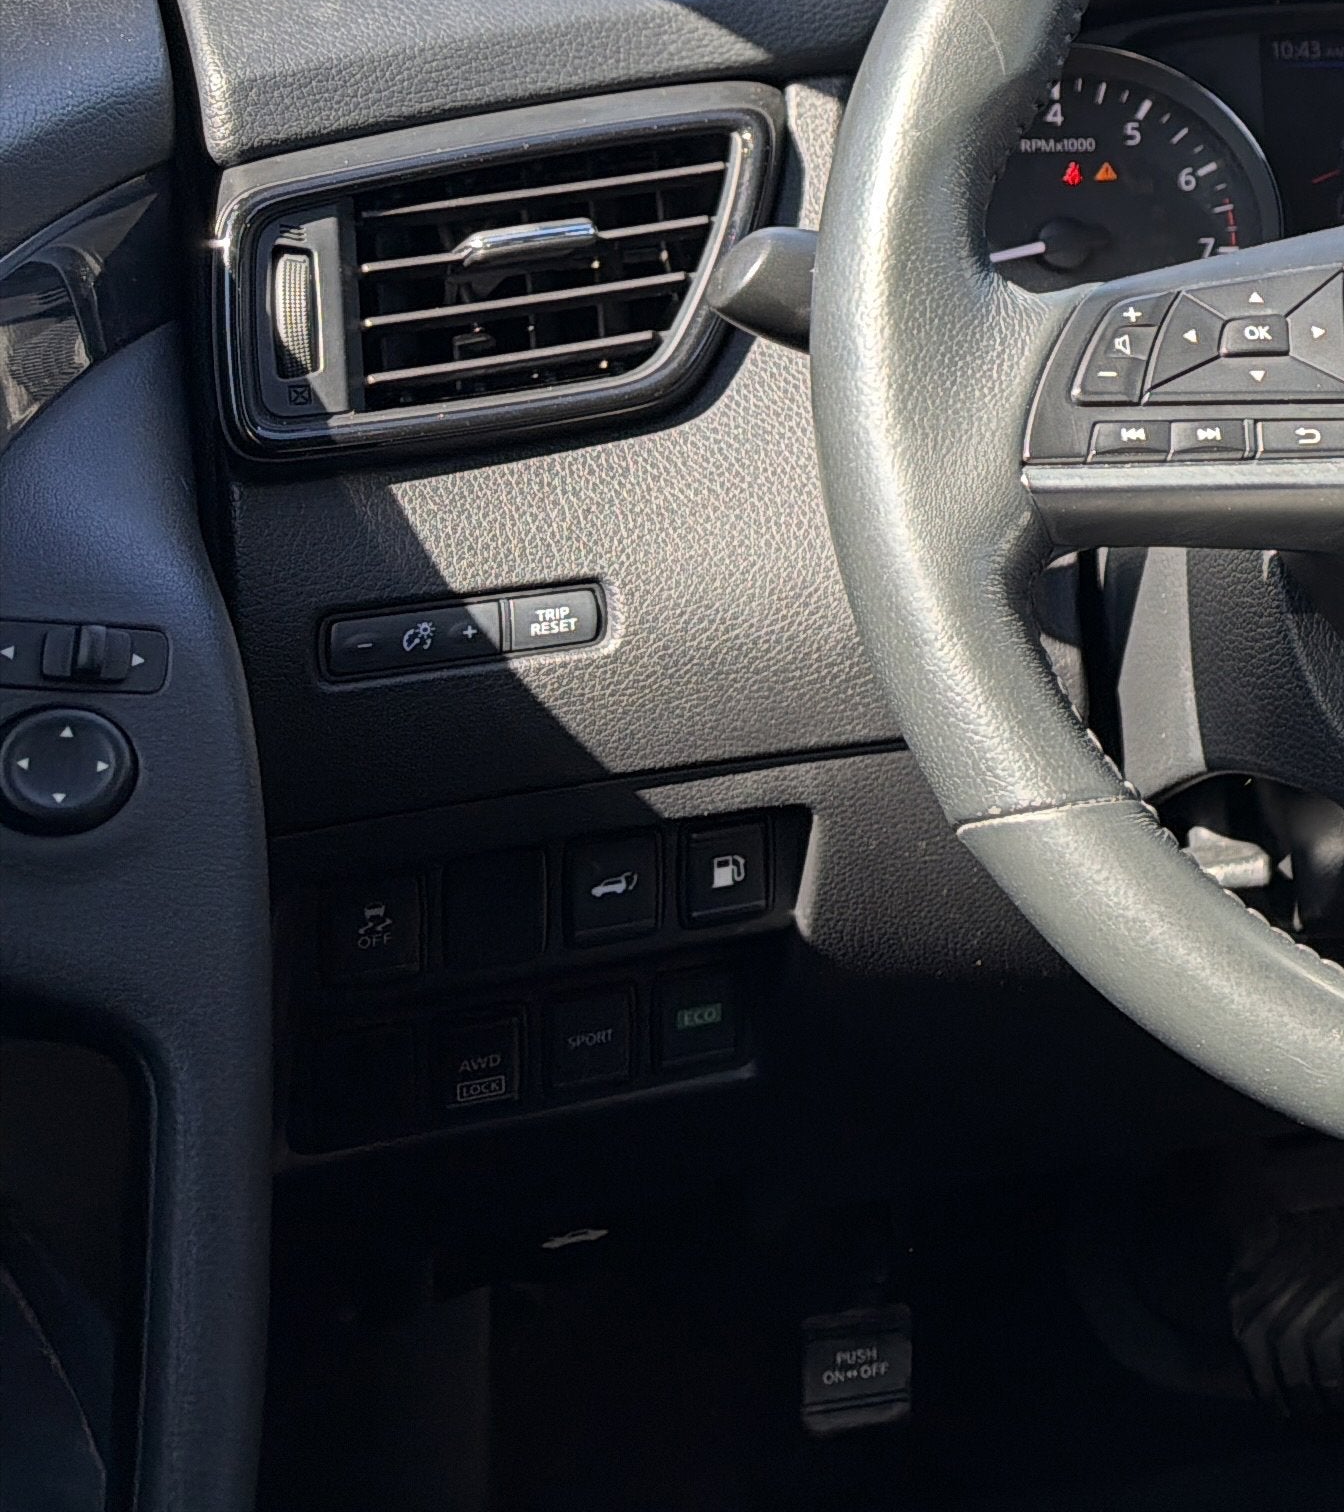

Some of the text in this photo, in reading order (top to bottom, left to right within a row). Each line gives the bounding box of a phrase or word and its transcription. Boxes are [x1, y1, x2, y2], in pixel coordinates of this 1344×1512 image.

[1043, 102, 1065, 127] 4
[1124, 122, 1141, 146] 5
[1020, 137, 1096, 153] RPMx1000
[1177, 169, 1197, 192] 6
[1198, 236, 1217, 259] 7
[1244, 325, 1273, 341] OK
[535, 606, 571, 623] TRIP
[530, 617, 578, 637] RESET
[357, 933, 393, 950] OFF
[683, 1007, 718, 1026] ECO
[567, 1029, 614, 1050] SPORT
[458, 1054, 502, 1074] AWD
[461, 1079, 502, 1098] LOCK
[836, 1347, 878, 1365] PUSH
